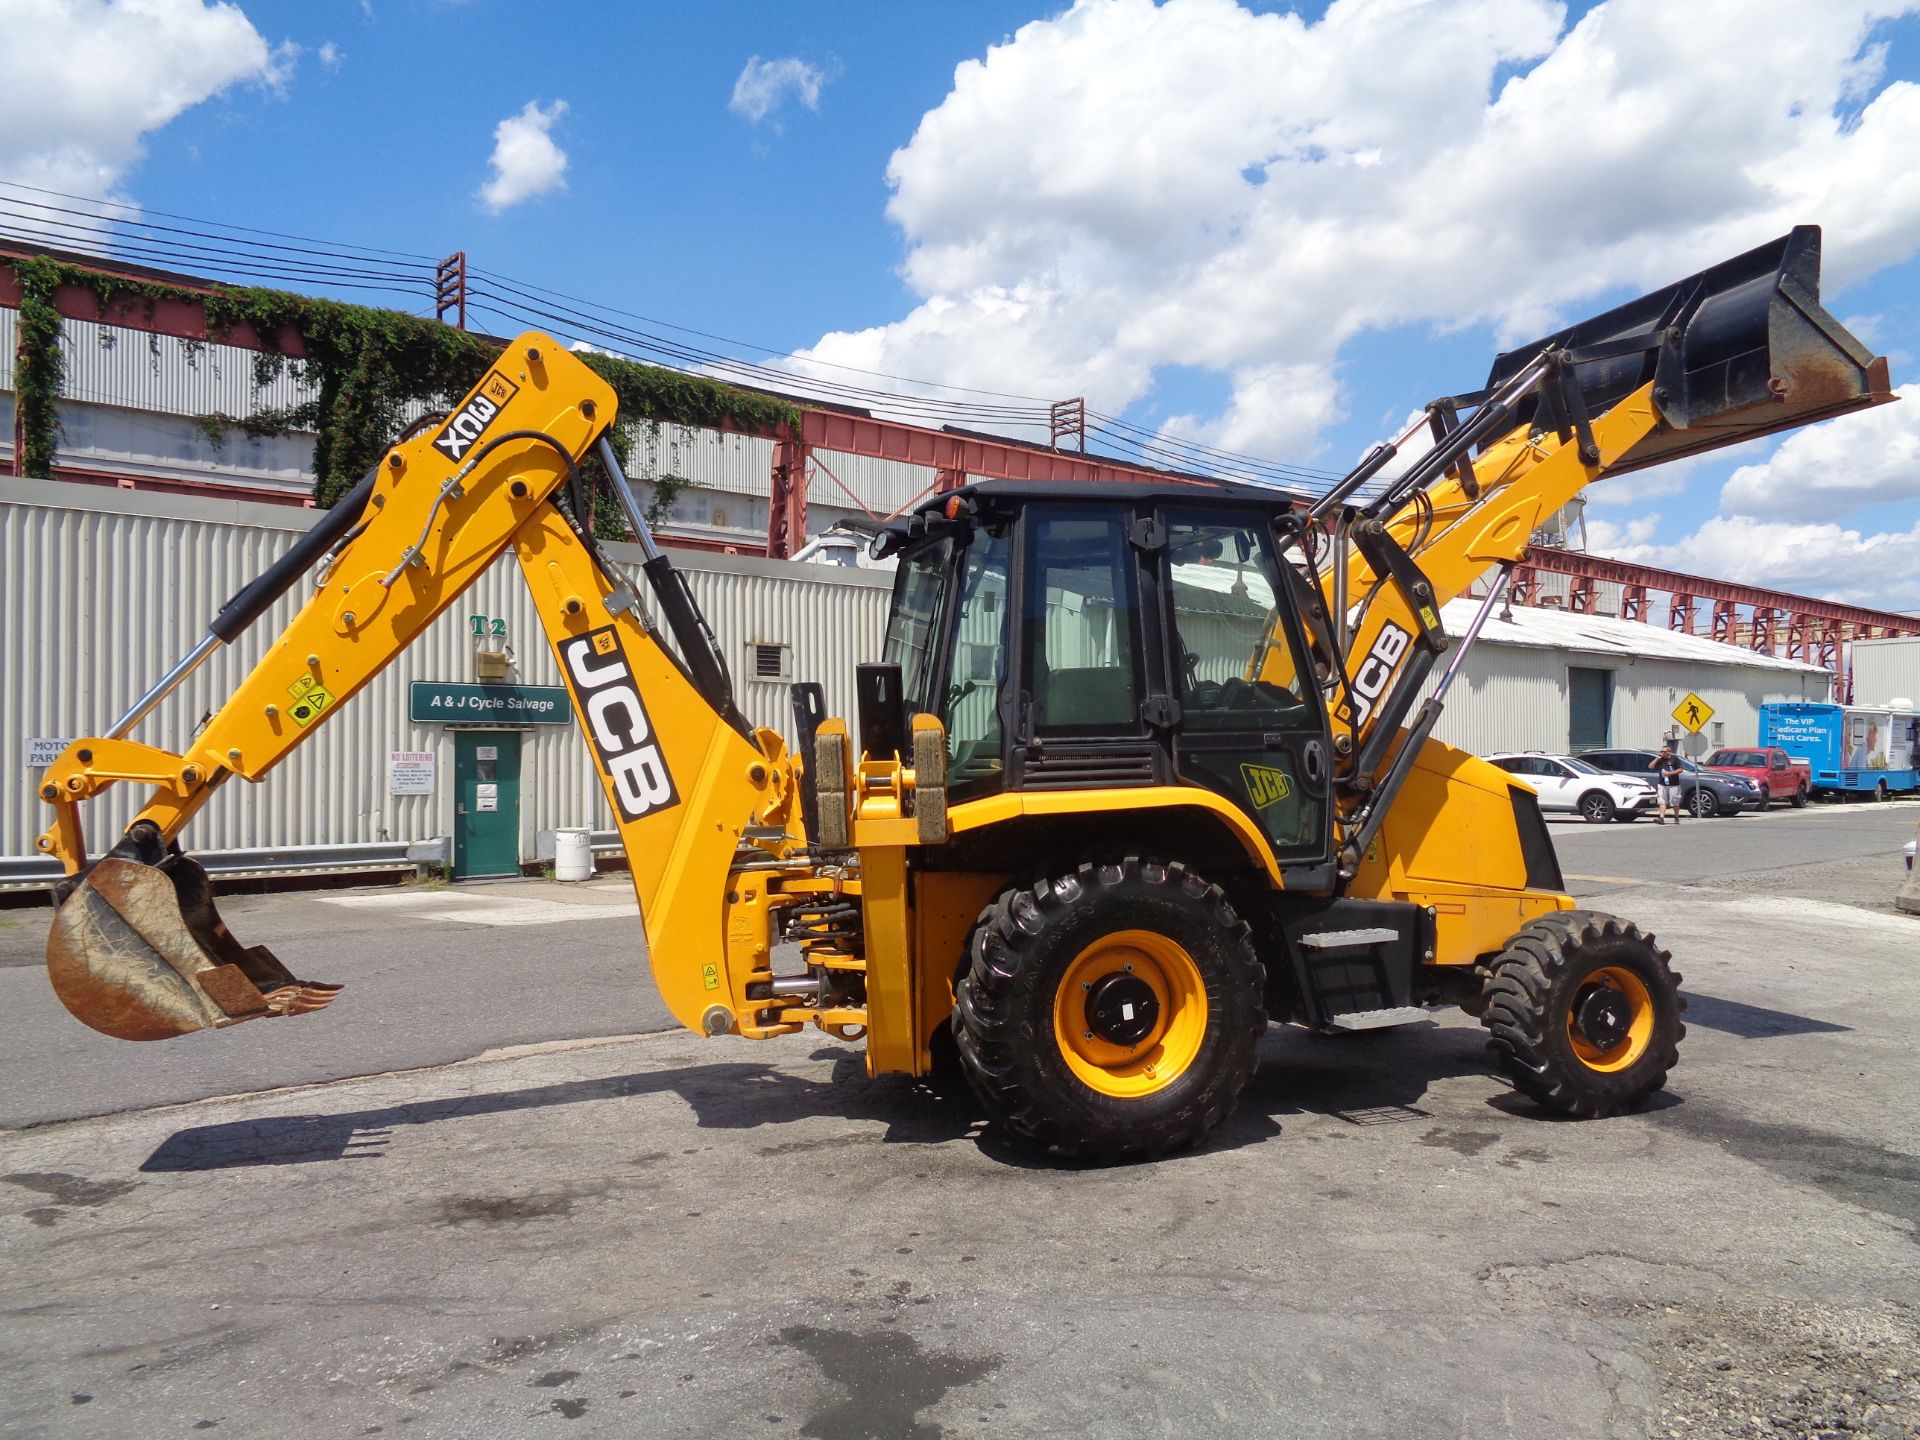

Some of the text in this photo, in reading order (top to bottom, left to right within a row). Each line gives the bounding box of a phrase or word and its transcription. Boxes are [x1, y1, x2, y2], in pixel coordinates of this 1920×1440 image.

[436, 396, 497, 459] 3CX
[1351, 624, 1408, 727] JCB
[430, 695, 554, 712] A & J Cycle Salvage
[567, 639, 671, 815] JCB
[1796, 734, 1822, 742] Cares.
[1808, 726, 1827, 734] Plan
[391, 753, 433, 761] NO LOITERING
[1249, 768, 1289, 804] JCB
